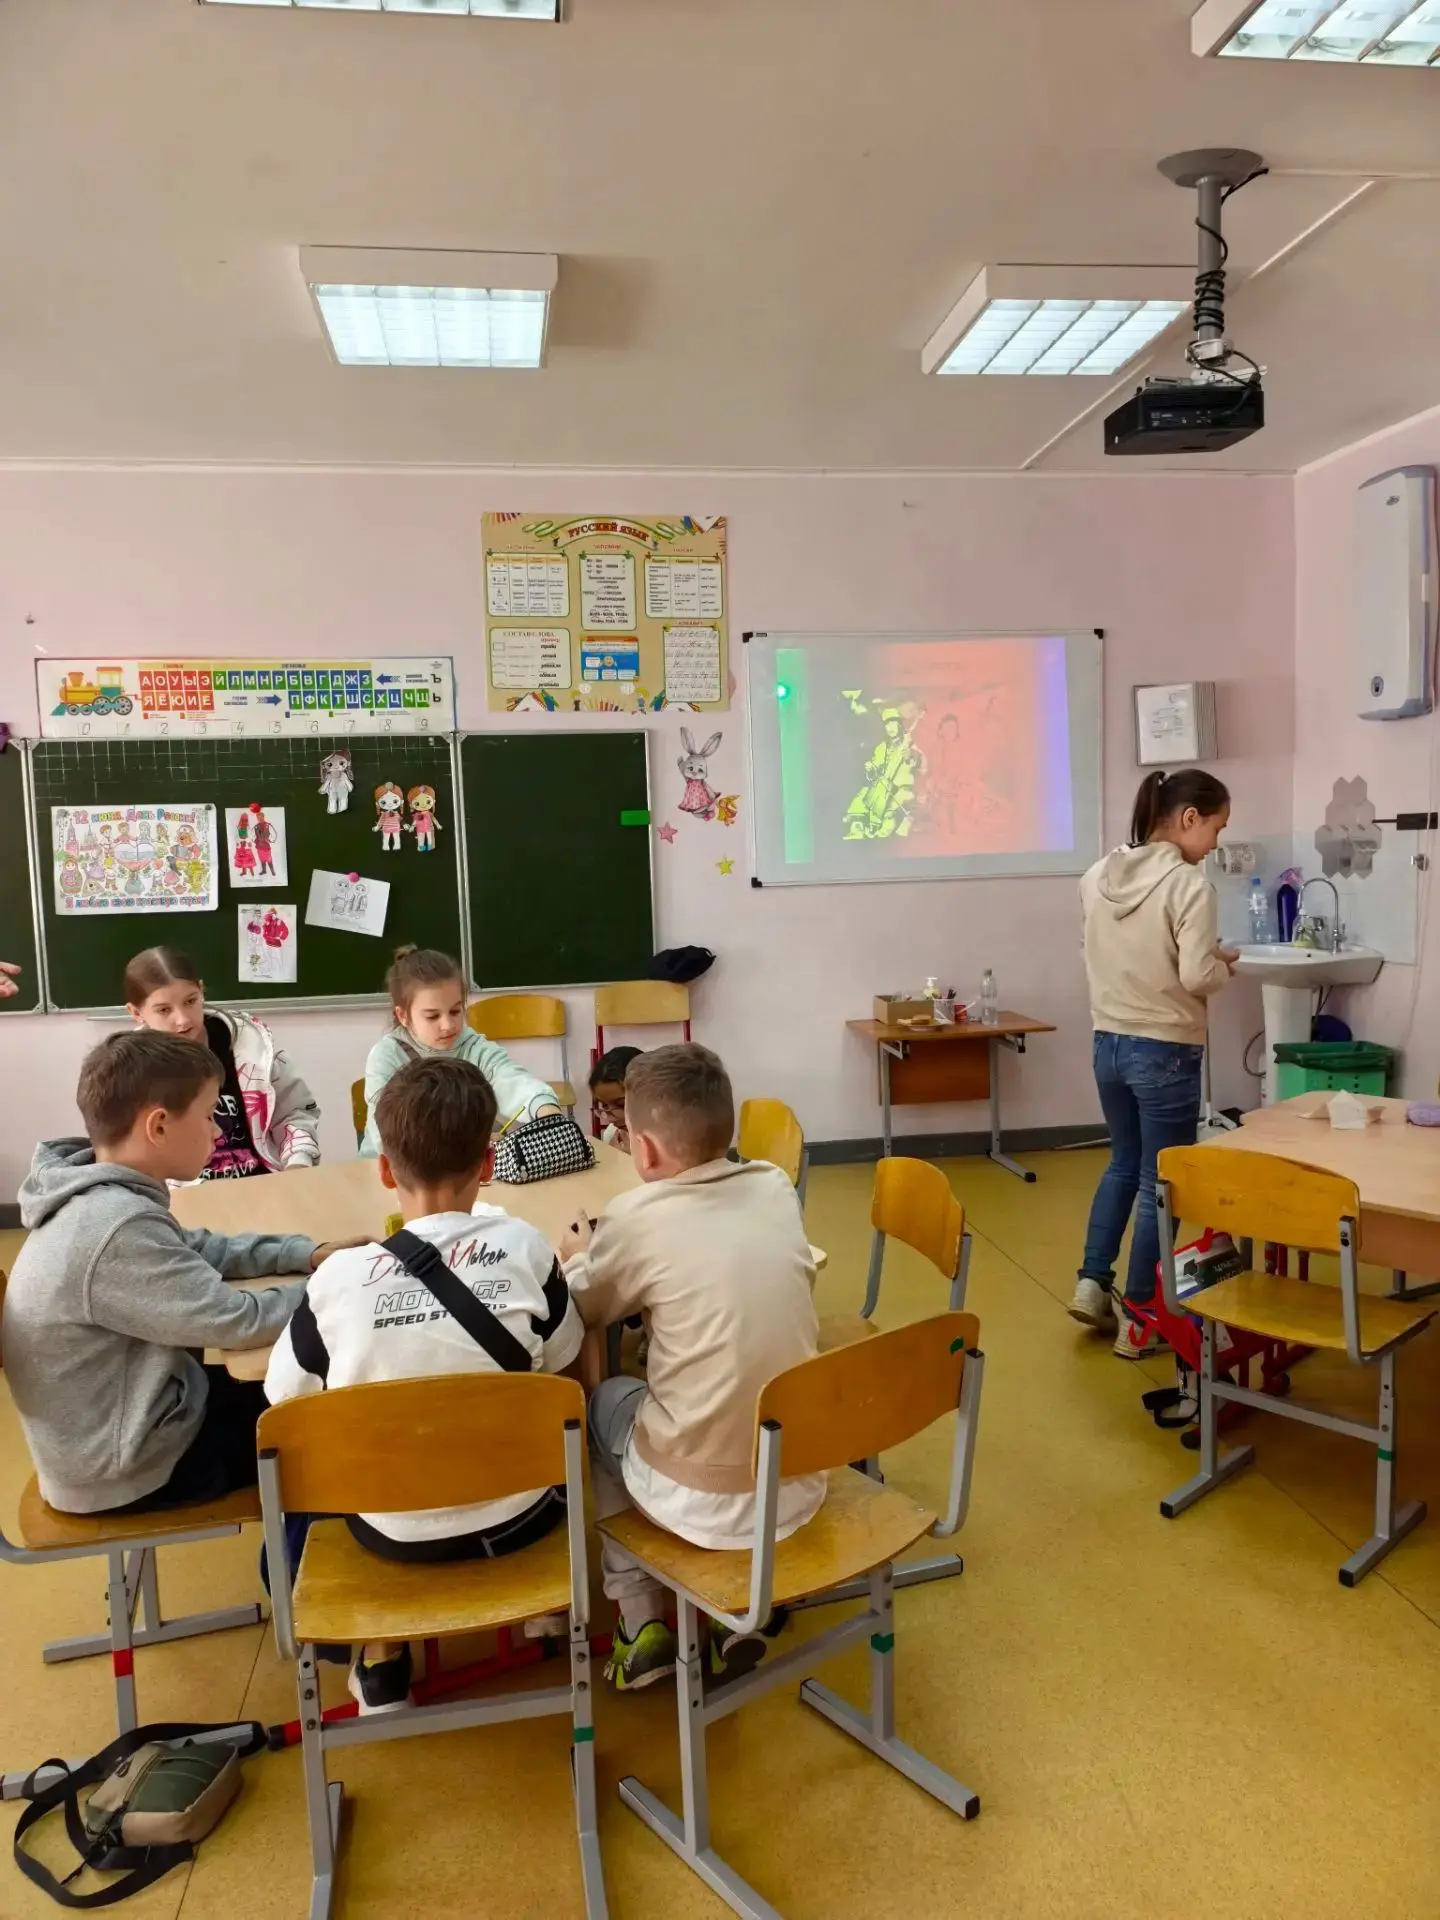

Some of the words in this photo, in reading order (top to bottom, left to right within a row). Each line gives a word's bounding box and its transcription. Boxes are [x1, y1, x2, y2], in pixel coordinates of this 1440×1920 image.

[568, 522, 618, 538] РУССКИЙ
[619, 525, 649, 541] ЯЗЫК
[142, 676, 151, 686] А
[156, 676, 165, 686] О
[170, 676, 179, 686] У
[185, 676, 197, 686] Ы
[201, 676, 209, 686] Э
[216, 673, 225, 685] Й
[231, 676, 240, 685] Л
[245, 676, 255, 685] М
[260, 676, 269, 685] Н
[275, 676, 283, 685] Р
[290, 675, 298, 685] Б
[304, 675, 312, 685] В
[320, 675, 326, 685] Г
[333, 675, 342, 686] Д
[346, 675, 357, 684] Ж
[362, 675, 369, 684] З
[430, 674, 441, 683] Ъ
[144, 696, 153, 705] Я
[172, 696, 184, 706] Ю
[188, 696, 196, 705] И
[203, 696, 211, 705] Е
[291, 695, 300, 704] П
[305, 694, 315, 704] Ф
[320, 695, 327, 704] К
[335, 694, 343, 704] Т
[347, 694, 358, 704] Ш
[362, 694, 371, 704] С
[377, 694, 385, 703] Х
[391, 694, 400, 705] Ц
[405, 693, 413, 703] Ч
[433, 693, 441, 702] Ь
[73, 810, 89, 824] 12
[126, 808, 155, 822] День
[448, 1239, 508, 1268] Maker
[373, 1313, 425, 1329] SPEED
